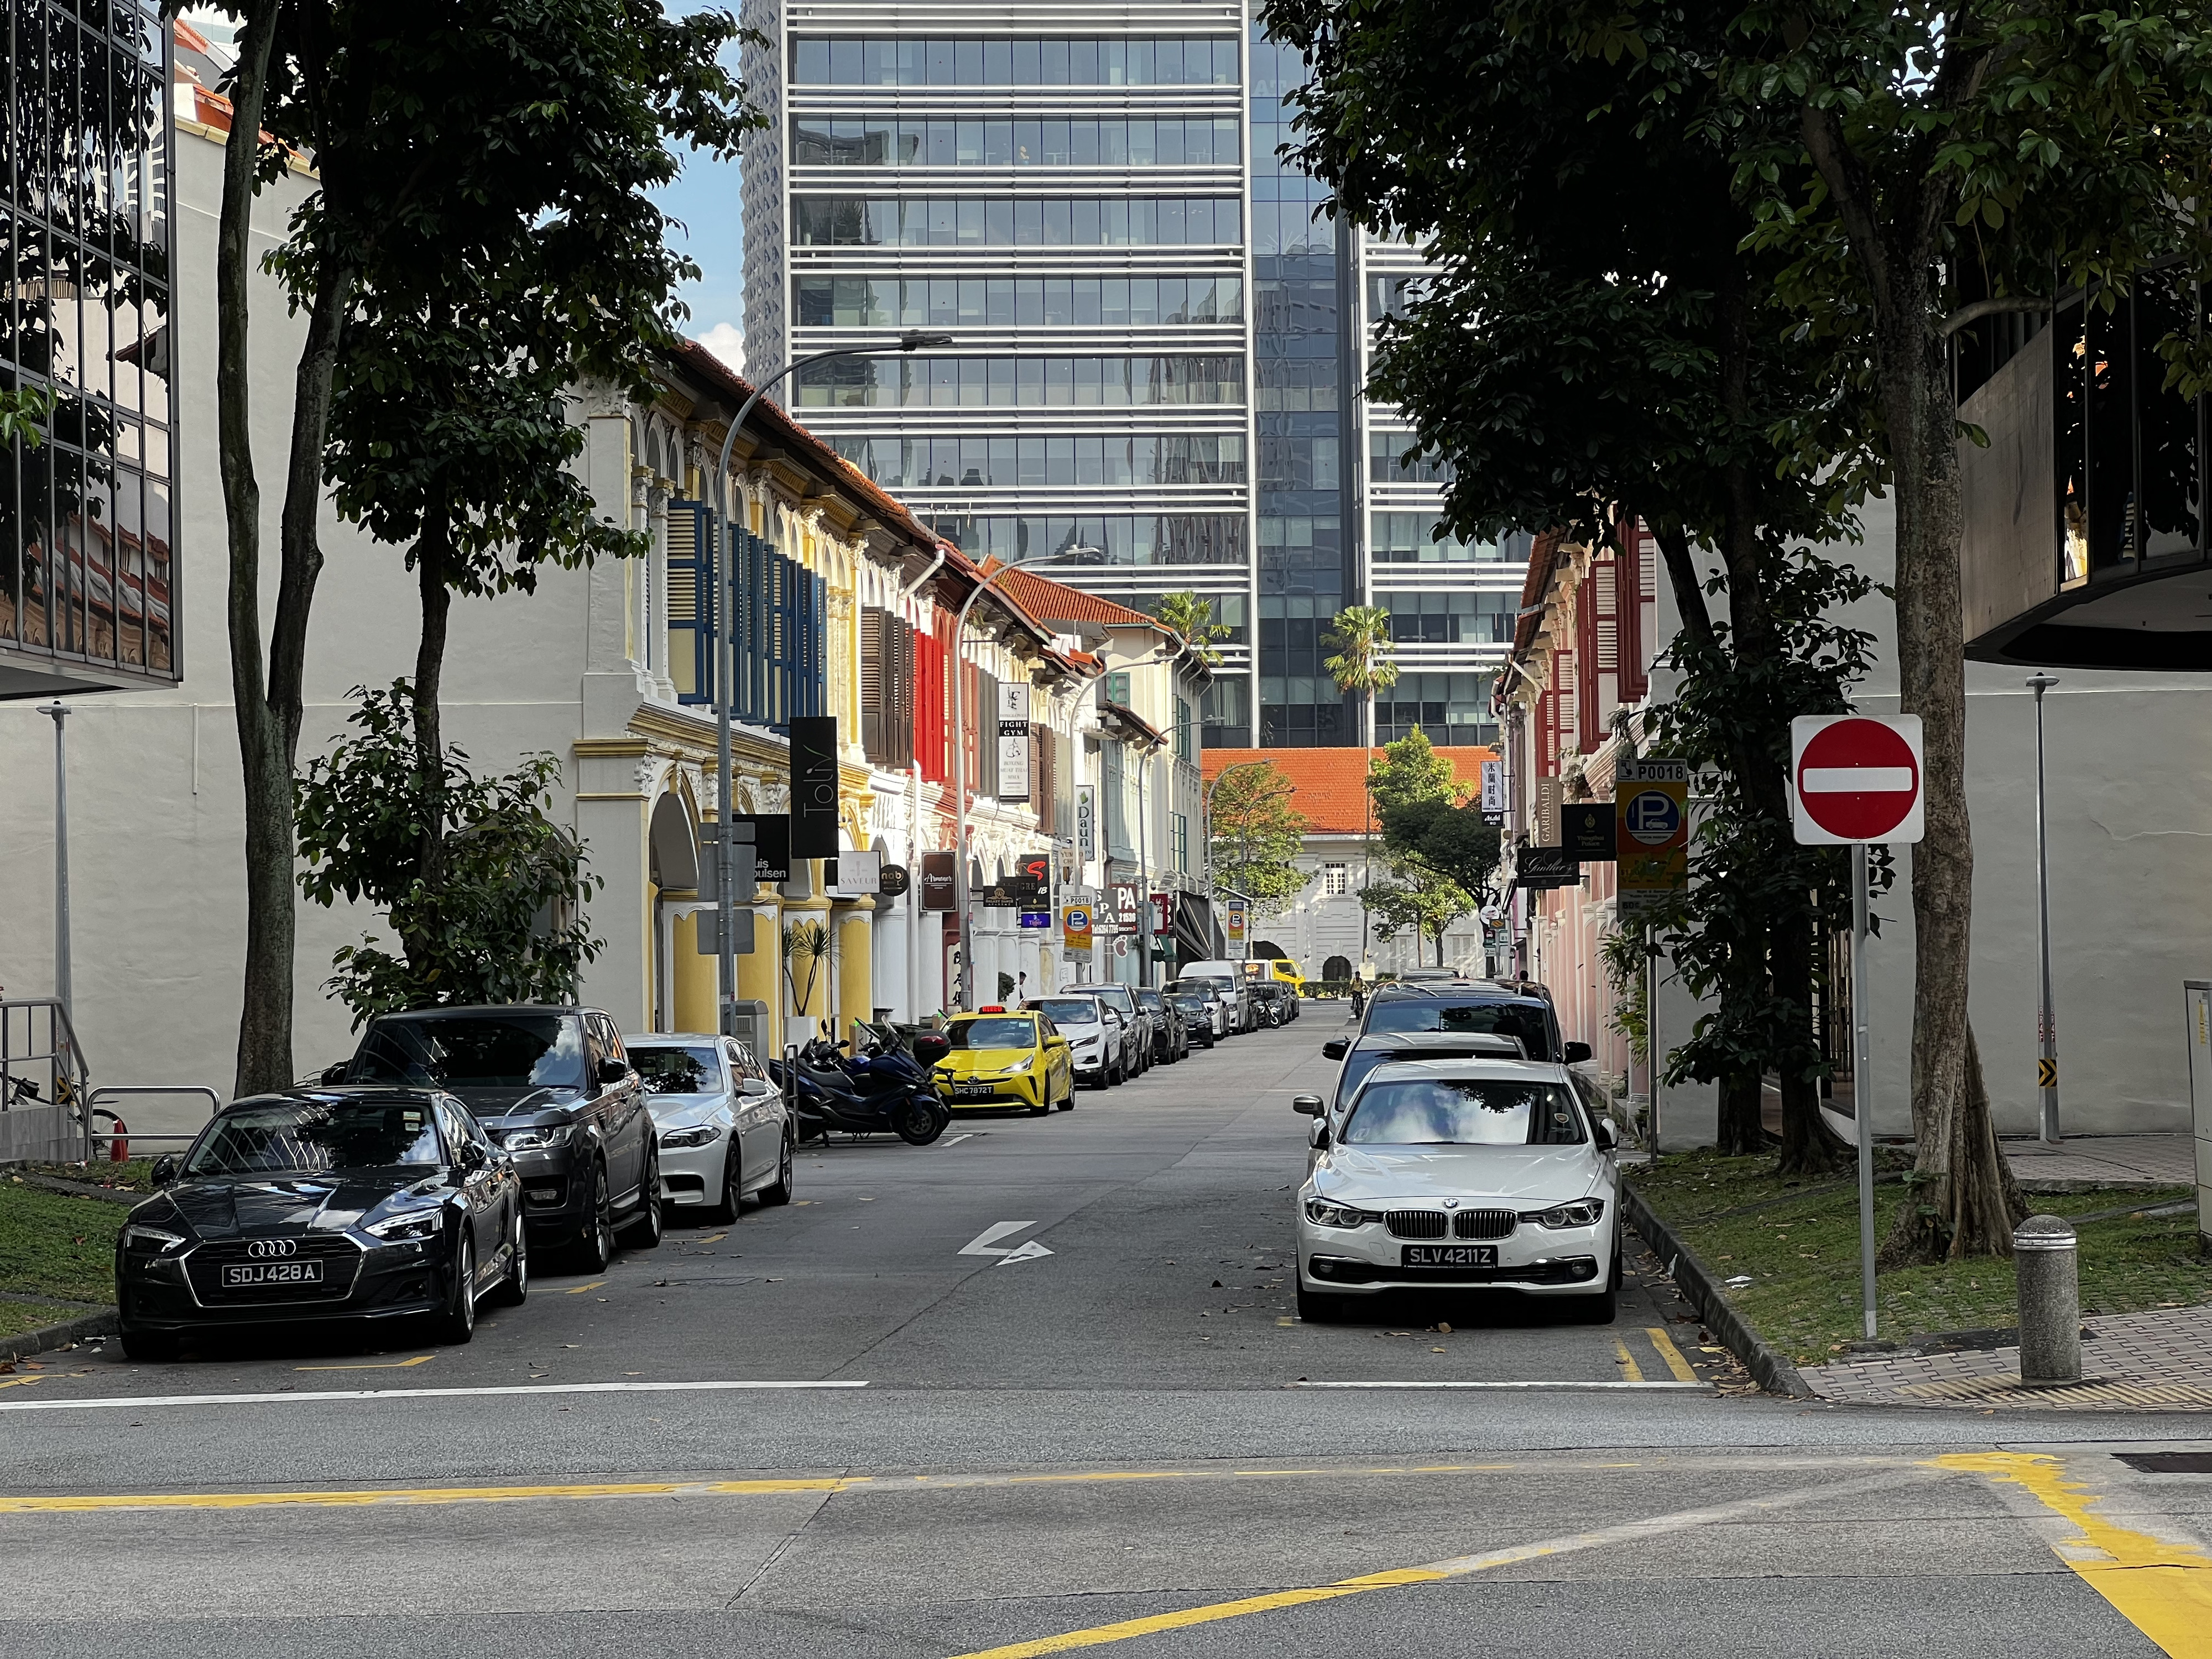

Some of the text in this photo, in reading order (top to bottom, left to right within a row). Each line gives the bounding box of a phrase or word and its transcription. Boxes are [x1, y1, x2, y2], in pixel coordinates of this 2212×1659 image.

[1639, 766, 1683, 779] P0018
[1541, 783, 1550, 842] GARIBALDI
[1639, 796, 1670, 830] P
[1079, 806, 1089, 847] Daun
[755, 858, 769, 868] uis
[754, 869, 786, 878] oulsen
[1117, 887, 1136, 909] PA
[1071, 911, 1084, 926] P
[1410, 1248, 1490, 1263] SLV4211Z
[230, 1263, 315, 1283] SDJ428A
